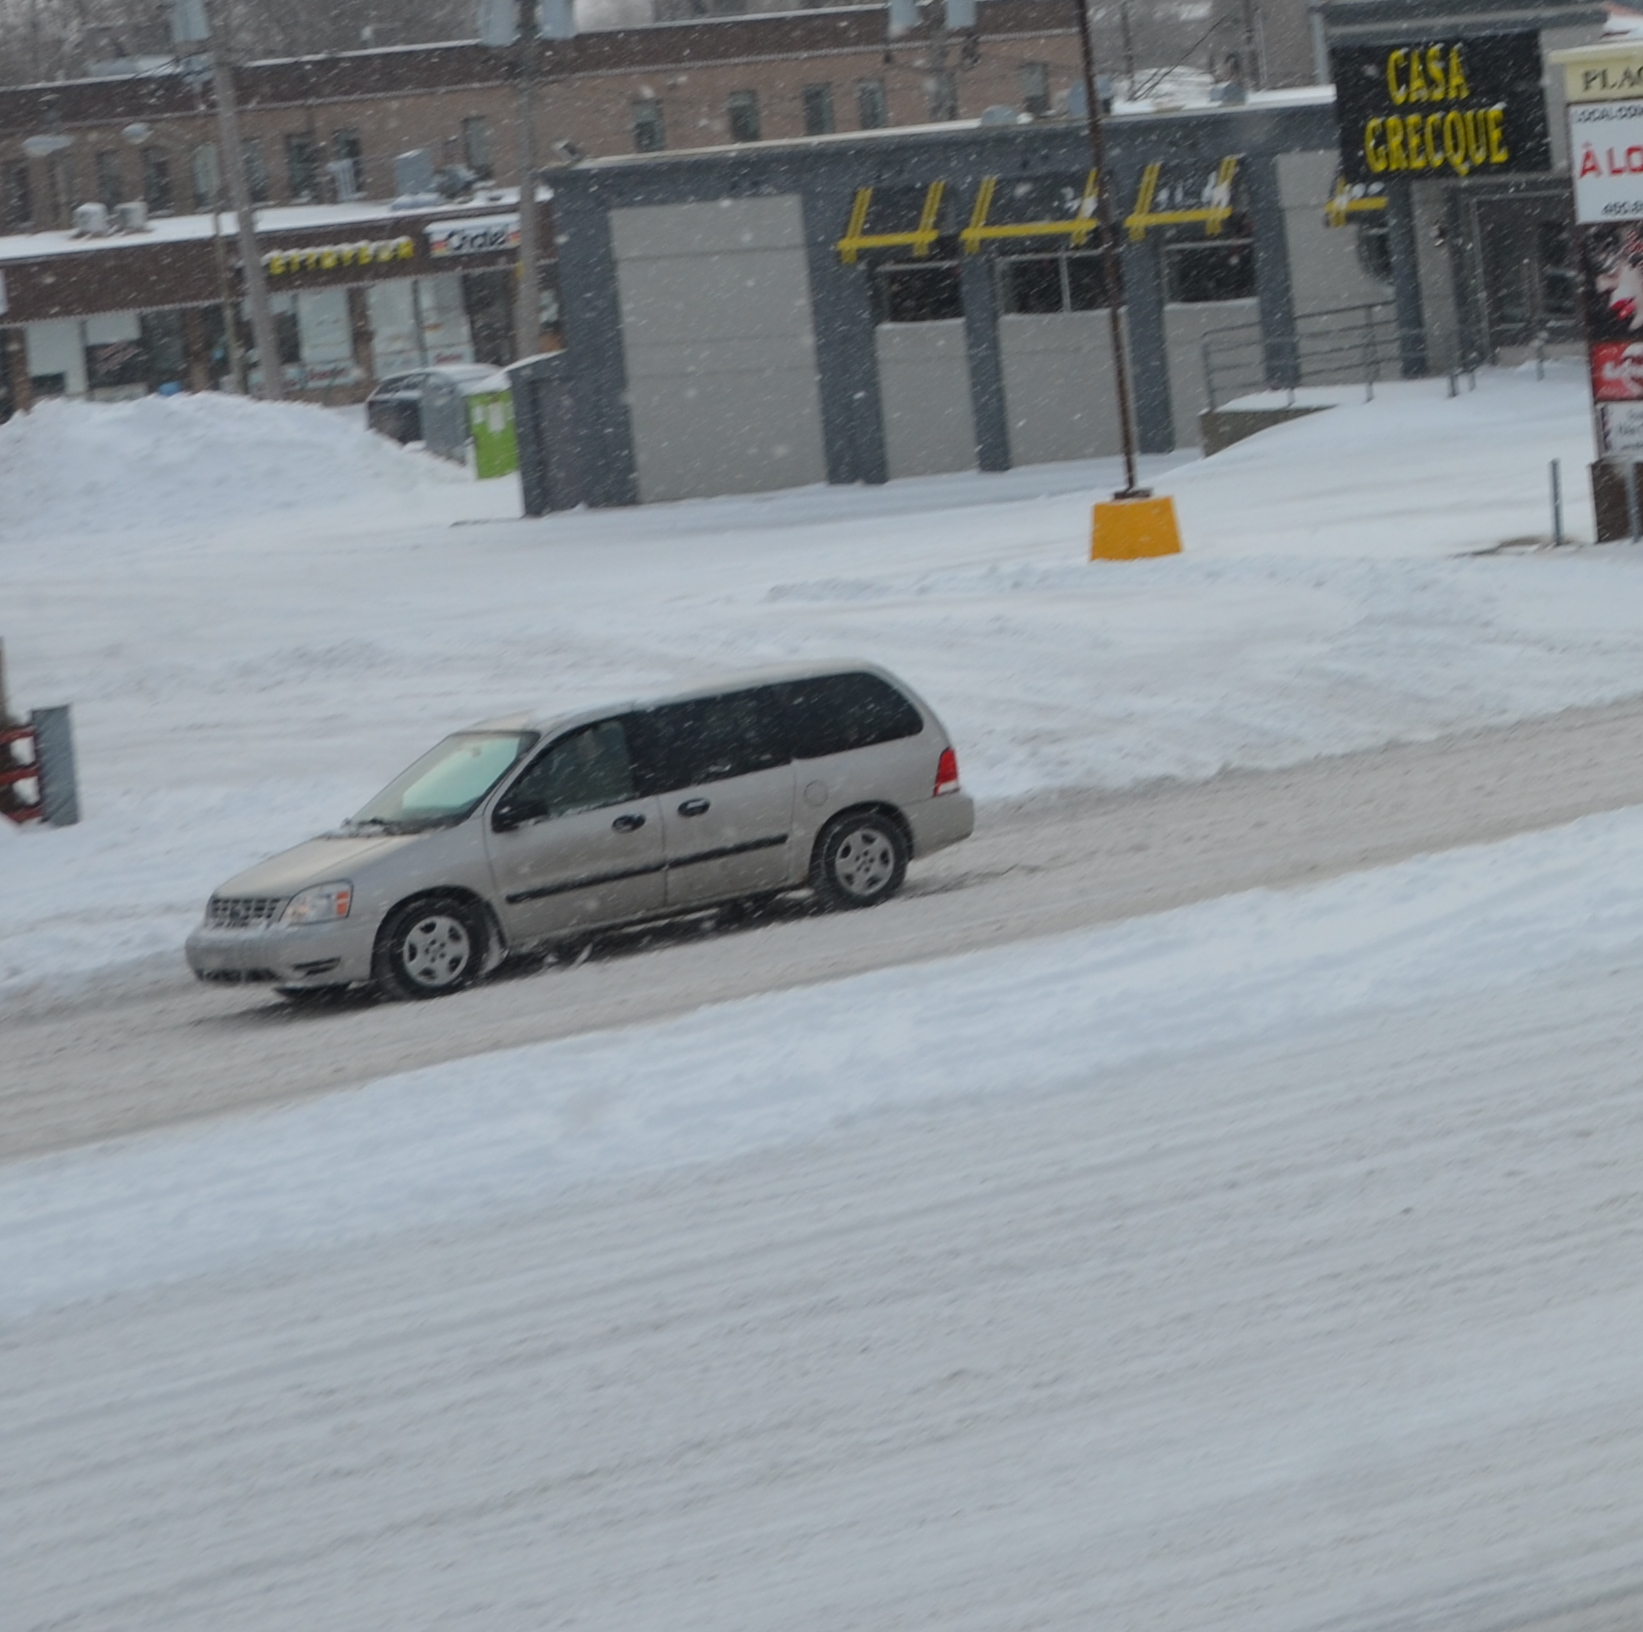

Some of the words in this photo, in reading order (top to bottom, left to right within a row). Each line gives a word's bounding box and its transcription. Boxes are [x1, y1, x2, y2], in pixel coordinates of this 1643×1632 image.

[1386, 44, 1470, 106] CASA
[1364, 106, 1509, 176] GRECQUE
[1579, 142, 1603, 179] À
